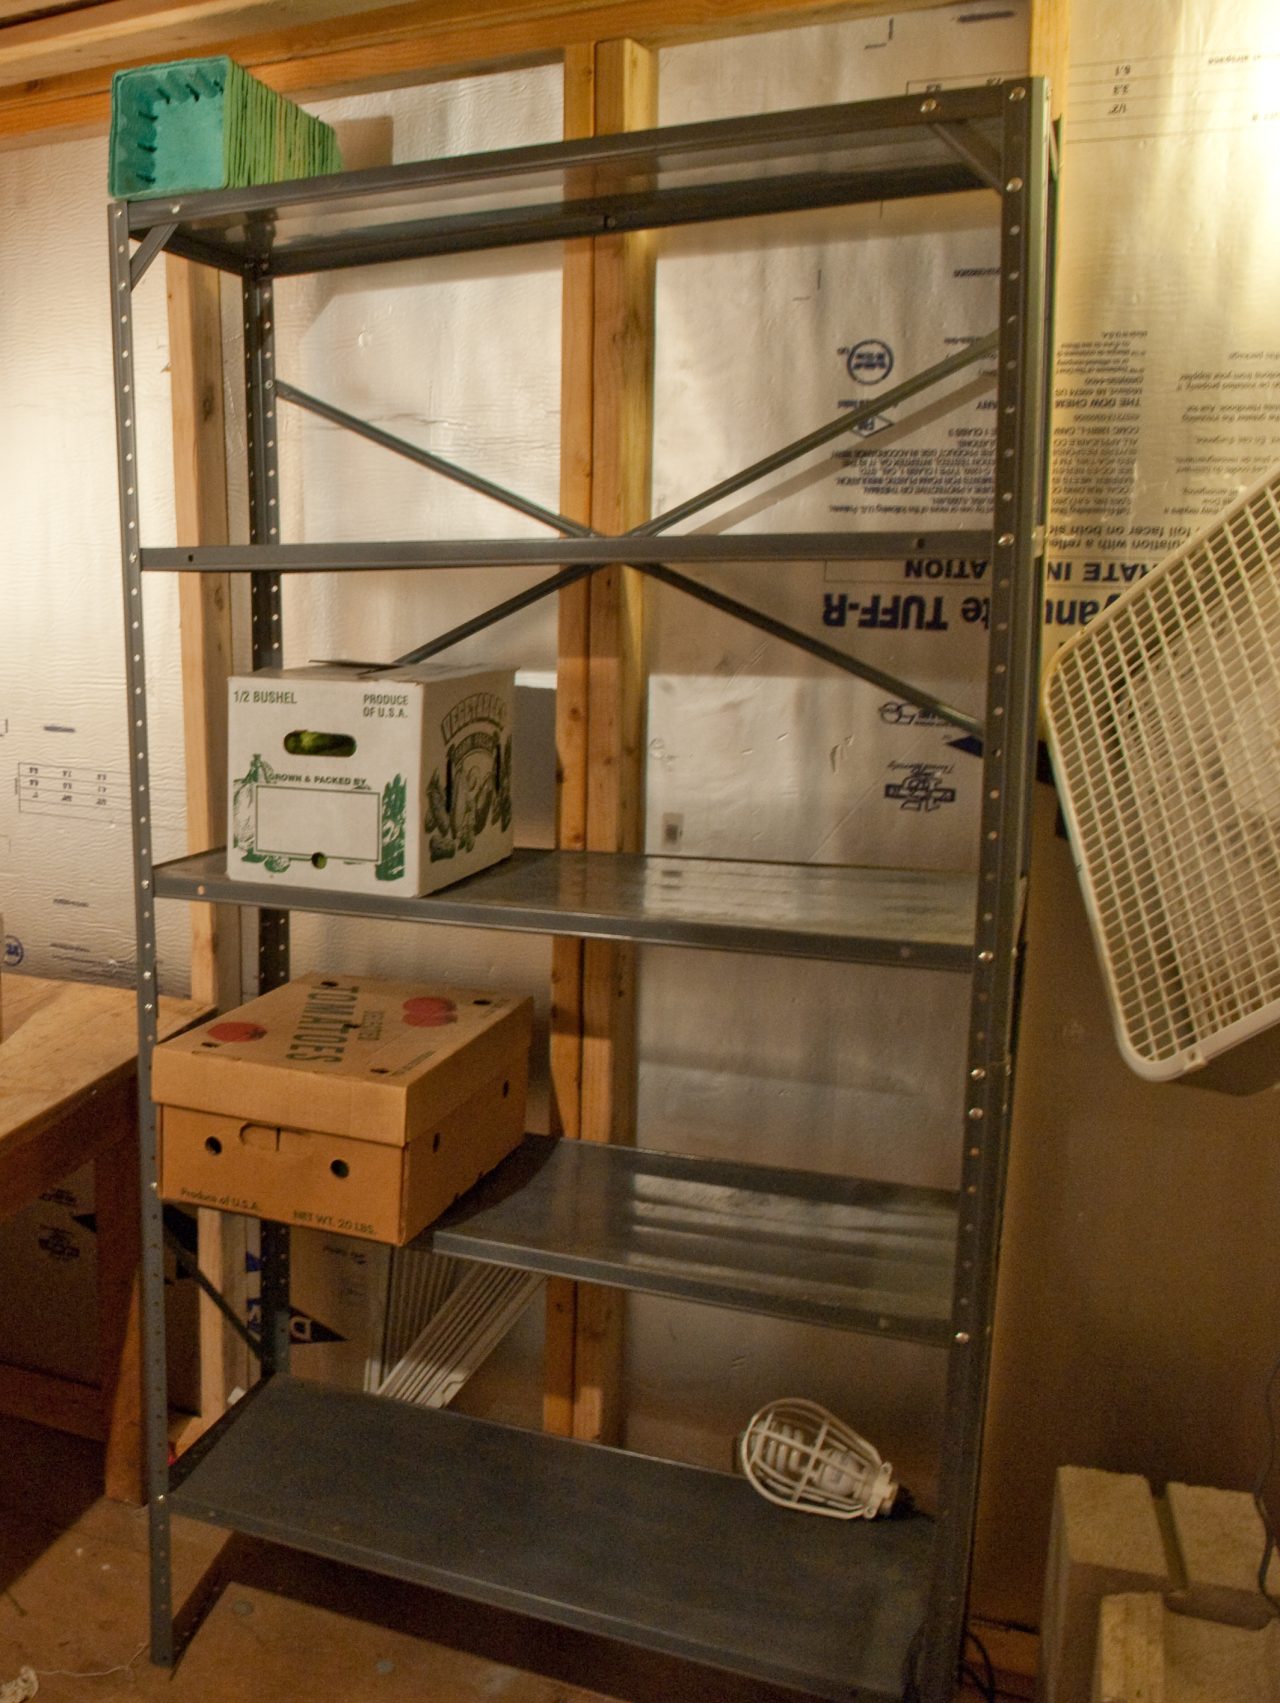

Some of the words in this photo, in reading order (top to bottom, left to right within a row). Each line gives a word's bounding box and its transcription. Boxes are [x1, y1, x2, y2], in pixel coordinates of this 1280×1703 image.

[1071, 527, 1102, 538] both
[1107, 527, 1125, 536] on
[1097, 539, 1127, 551] with
[821, 593, 949, 632] TUFF-R
[234, 691, 250, 703] 1/2
[253, 691, 297, 704] BUSHEL
[363, 694, 409, 706] PRODUCE
[363, 707, 375, 718] OF
[378, 707, 408, 719] U.S.A.
[269, 772, 303, 782] GROWN
[304, 774, 311, 783] &
[314, 775, 351, 785] PACKED
[354, 778, 367, 786] BY
[286, 985, 361, 1064] TOMATOES
[181, 1187, 219, 1203] Produce
[220, 1195, 230, 1206] of
[294, 1209, 314, 1222] NET
[338, 1219, 352, 1231] 20
